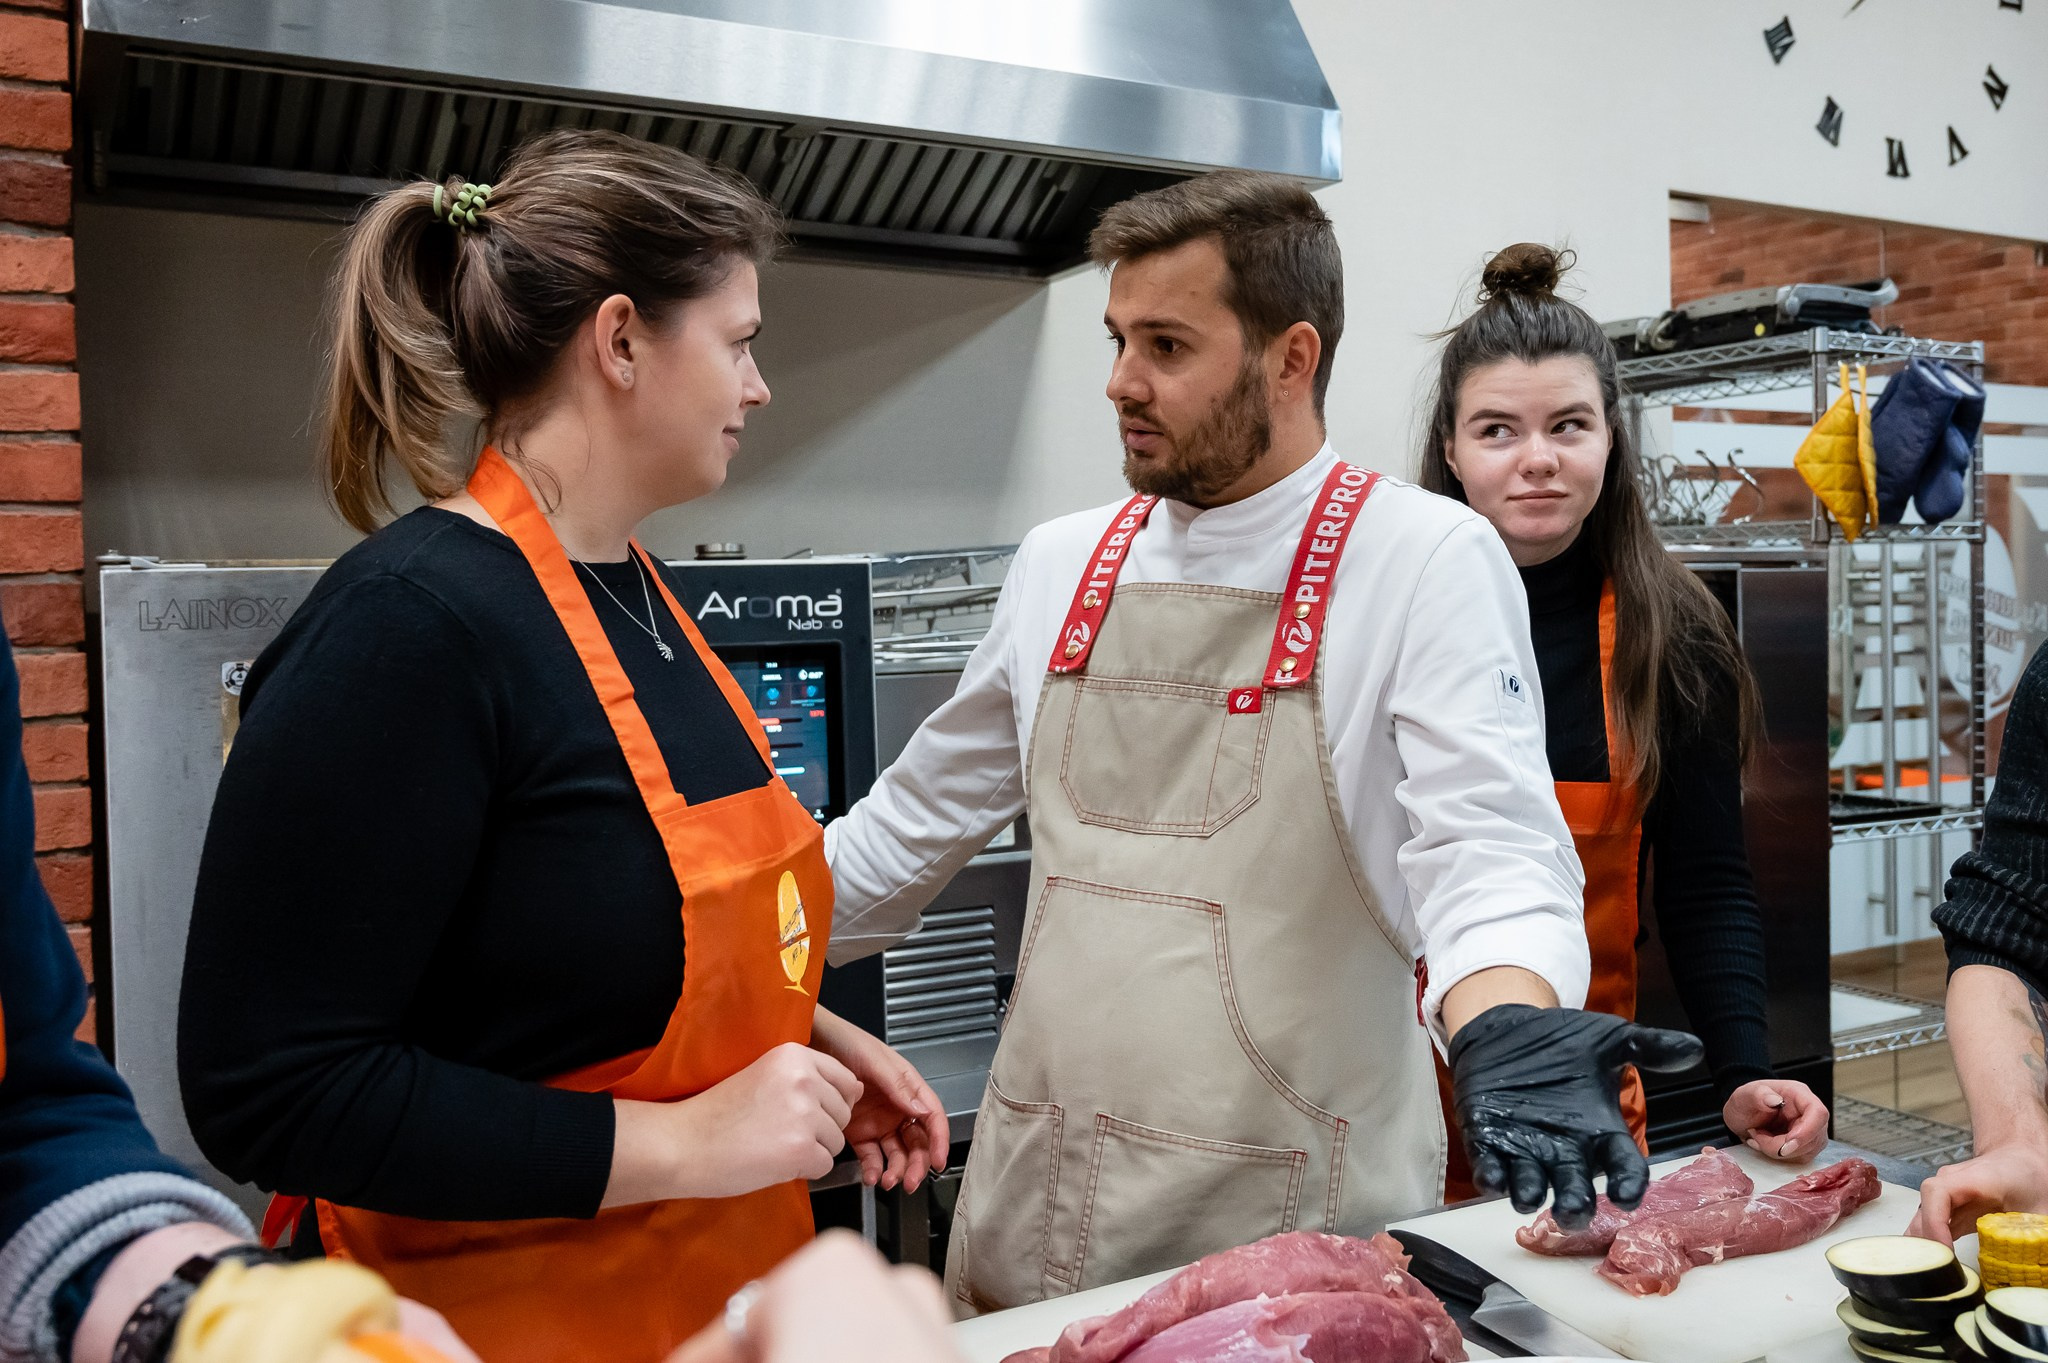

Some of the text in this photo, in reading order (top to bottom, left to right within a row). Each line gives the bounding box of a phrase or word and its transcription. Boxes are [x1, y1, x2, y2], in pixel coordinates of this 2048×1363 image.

[1082, 494, 1156, 606] PITERPR
[138, 597, 288, 631] LAINOX
[697, 590, 843, 620] Aroma
[787, 618, 843, 631] Nabo
